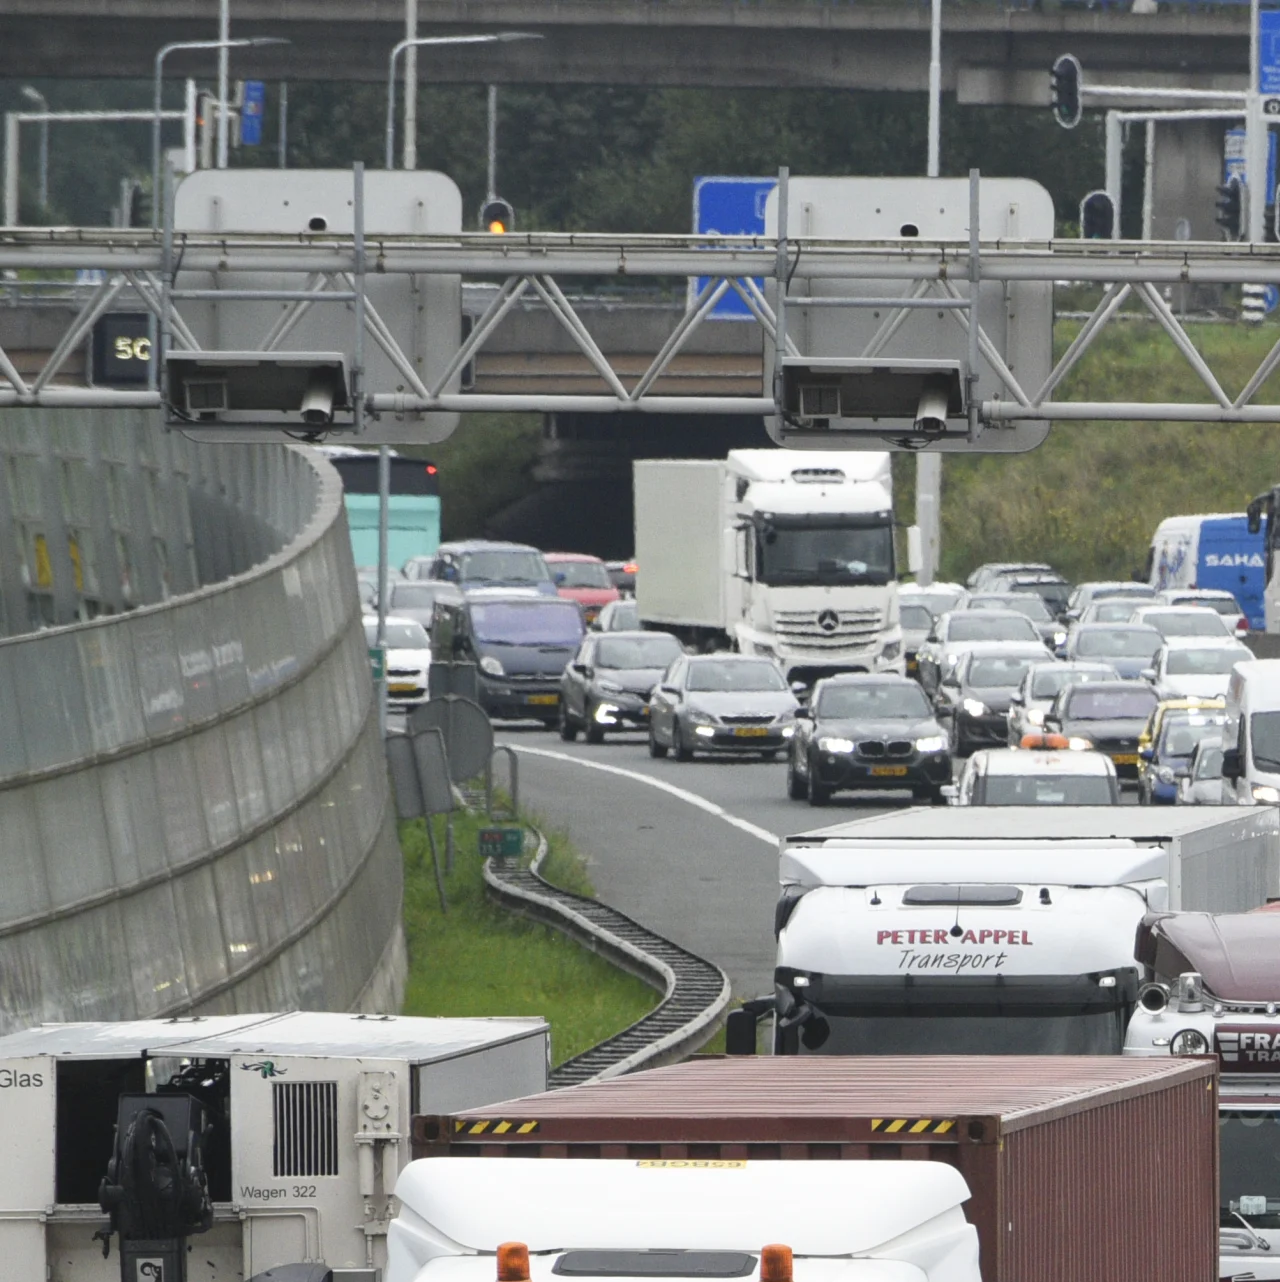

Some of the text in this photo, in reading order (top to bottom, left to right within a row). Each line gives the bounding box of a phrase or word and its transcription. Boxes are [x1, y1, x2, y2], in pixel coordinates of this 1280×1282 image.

[876, 929, 1033, 946] PETER APPEL
[898, 949, 1008, 974] Transport
[0, 1069, 43, 1088] Glas
[240, 1185, 317, 1201] Wagen 322
